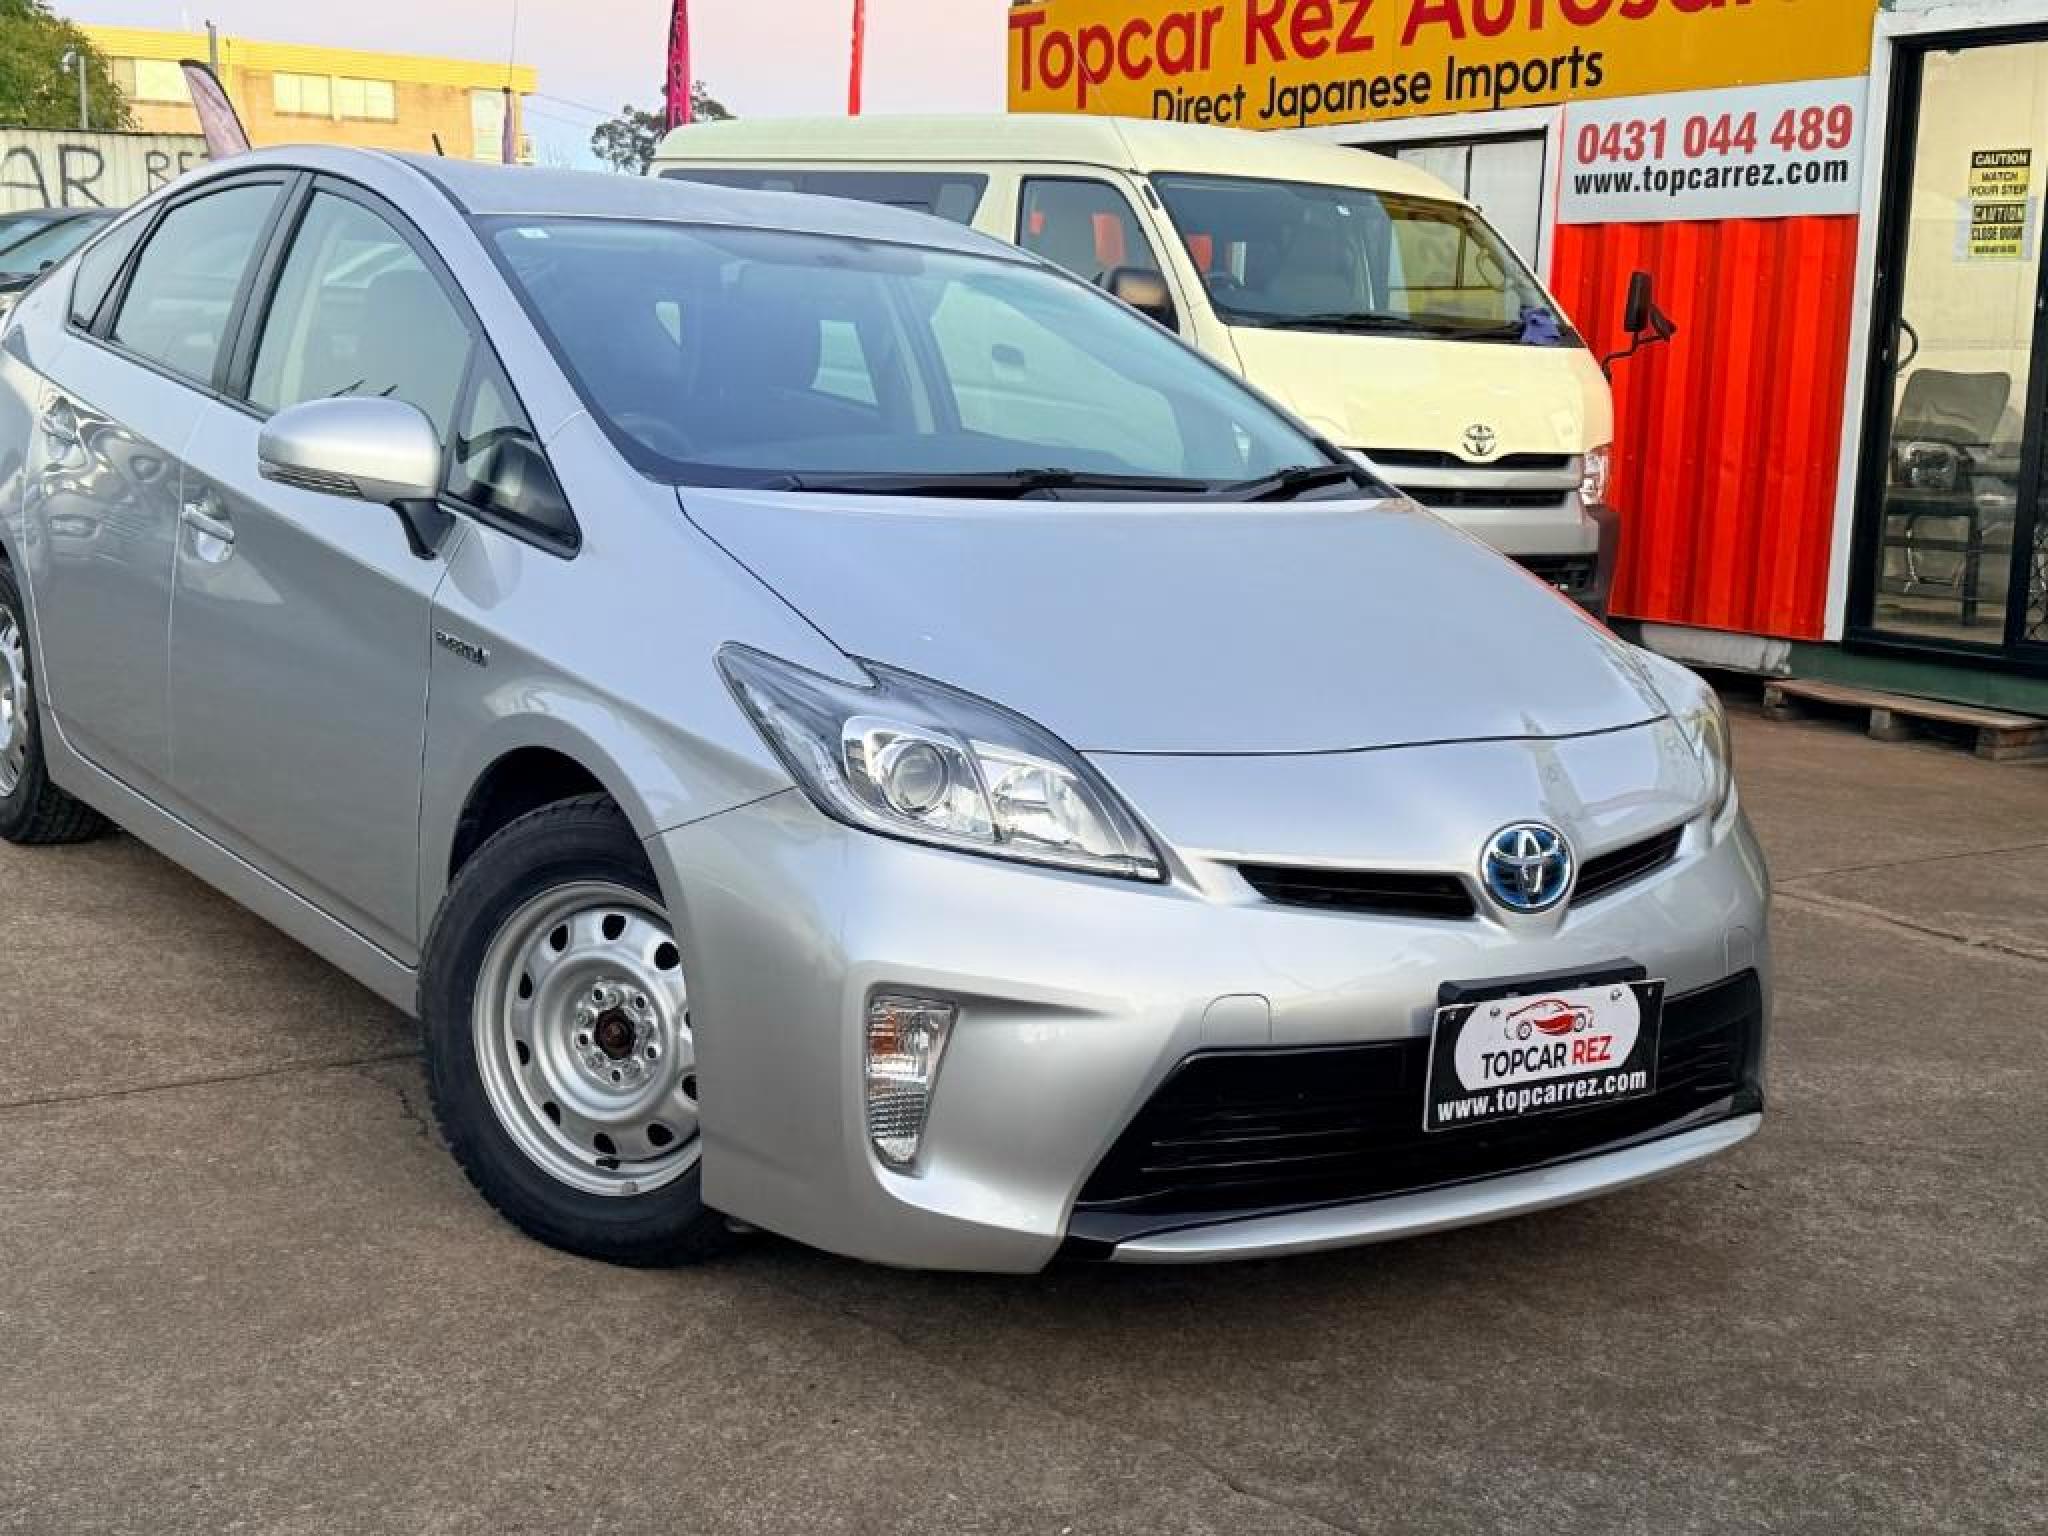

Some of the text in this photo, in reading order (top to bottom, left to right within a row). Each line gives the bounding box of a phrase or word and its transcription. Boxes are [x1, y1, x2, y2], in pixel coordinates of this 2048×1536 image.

[1008, 6, 1225, 109] Topcar
[1244, 0, 1375, 64] Rez
[1153, 46, 1603, 128] Direct Japanese Imports
[1577, 103, 1853, 165] 0431 044 489
[1574, 159, 1848, 197] www.topcarrez.com
[1975, 152, 2028, 166] CAUTION
[1973, 205, 2024, 222] CAUTION
[1481, 1035, 1613, 1079] TOPCAR REZ
[1438, 1069, 1647, 1121] www.topcarrez.com
